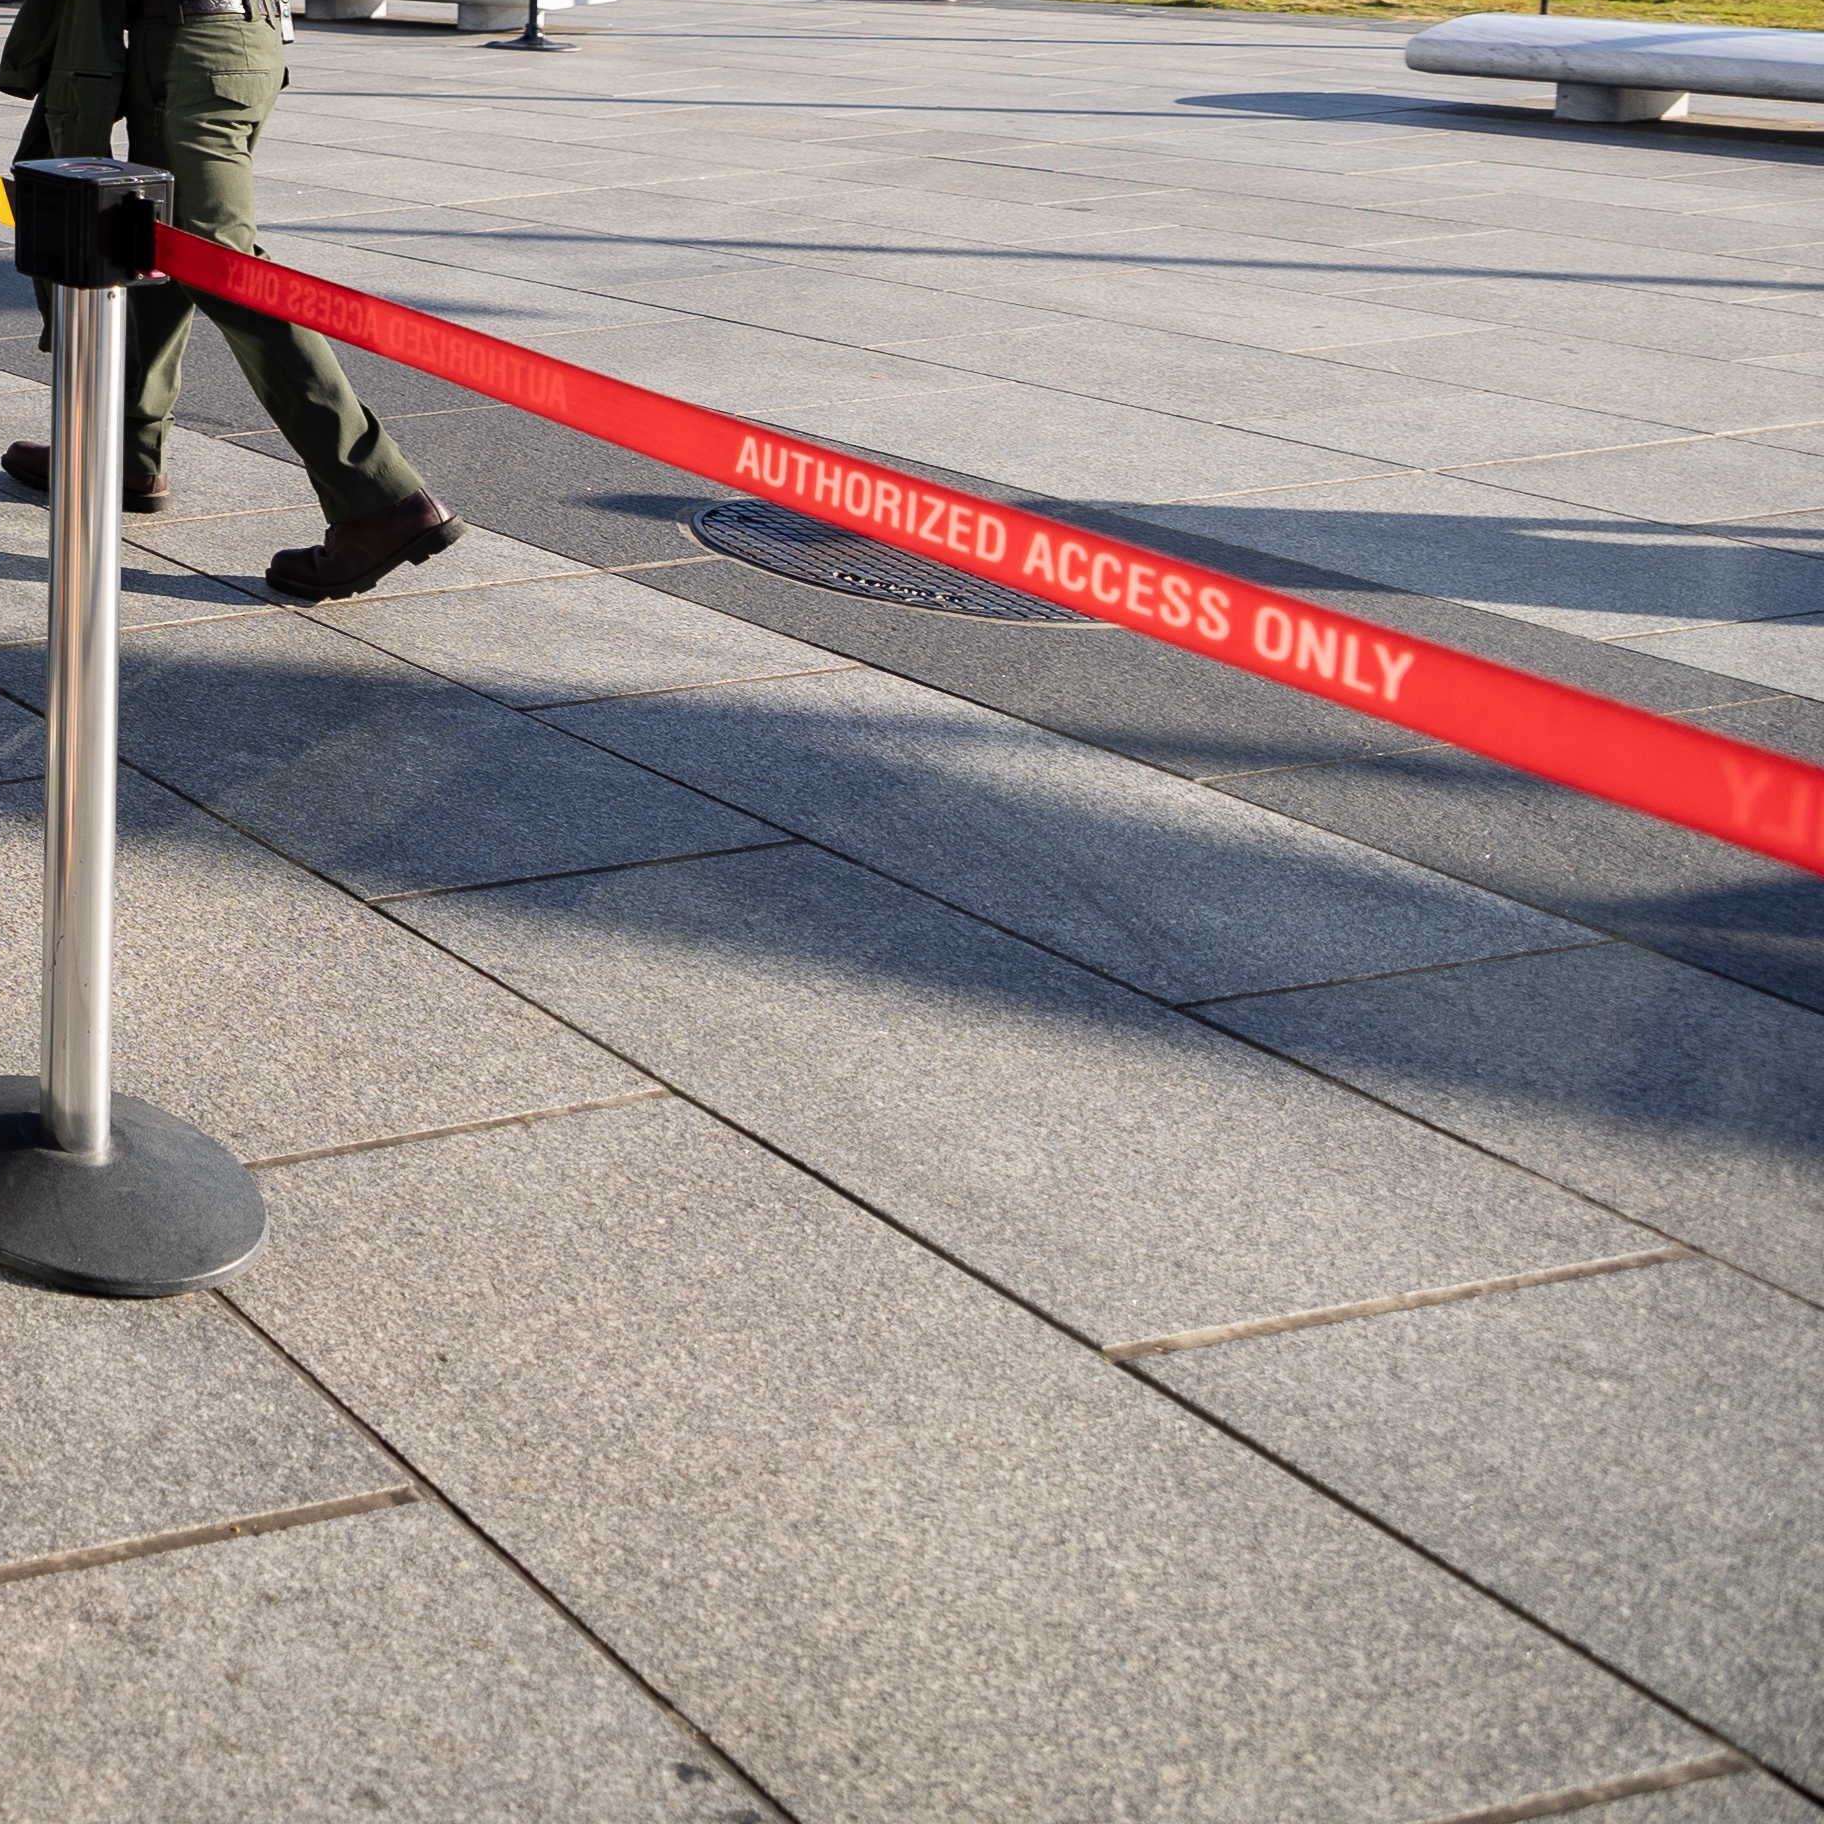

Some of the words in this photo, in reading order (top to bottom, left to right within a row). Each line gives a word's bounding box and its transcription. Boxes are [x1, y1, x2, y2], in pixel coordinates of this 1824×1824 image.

[735, 436, 1007, 564] AUTHORIZED
[1022, 532, 1231, 641] ACCESS
[1254, 605, 1414, 702] ONLY
